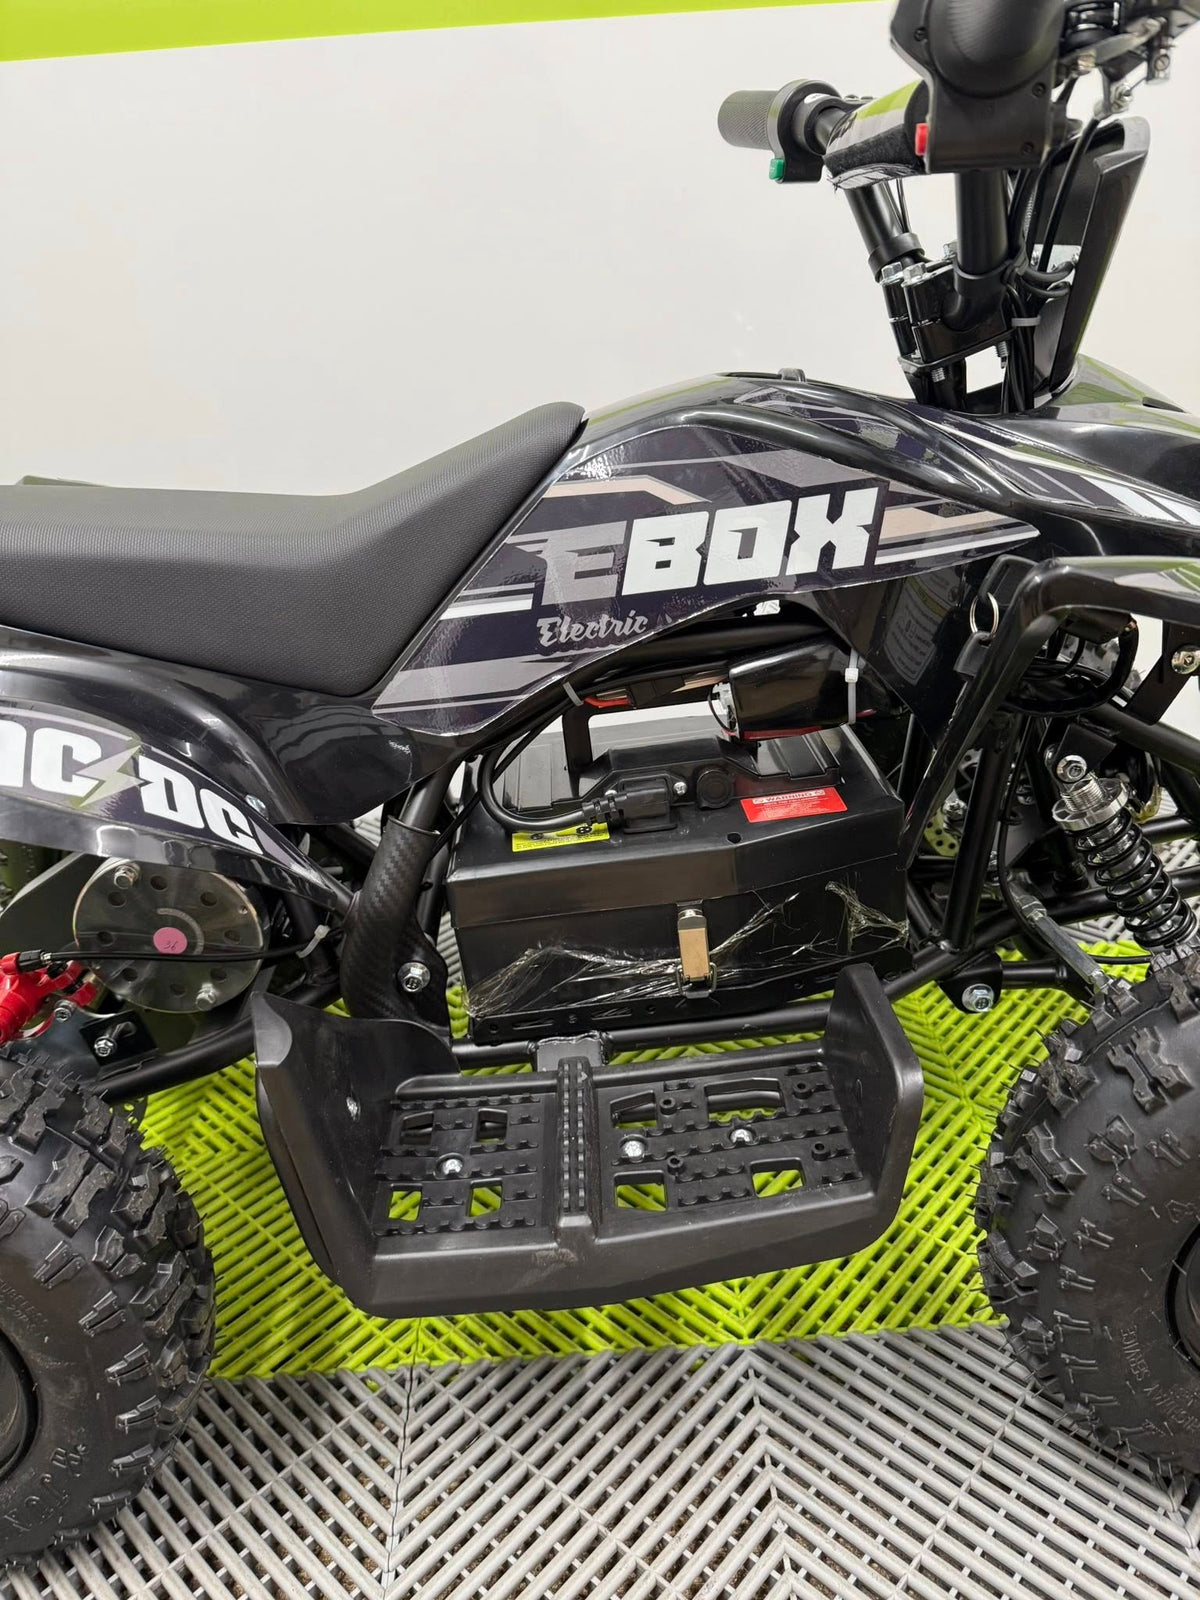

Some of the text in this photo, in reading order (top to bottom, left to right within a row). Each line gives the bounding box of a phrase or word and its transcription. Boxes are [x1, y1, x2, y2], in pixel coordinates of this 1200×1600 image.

[520, 487, 878, 605] EBOX
[536, 609, 649, 647] Electric
[139, 755, 263, 854] DC
[765, 791, 813, 803] WARNING
[1120, 1324, 1151, 1382] SERVICE
